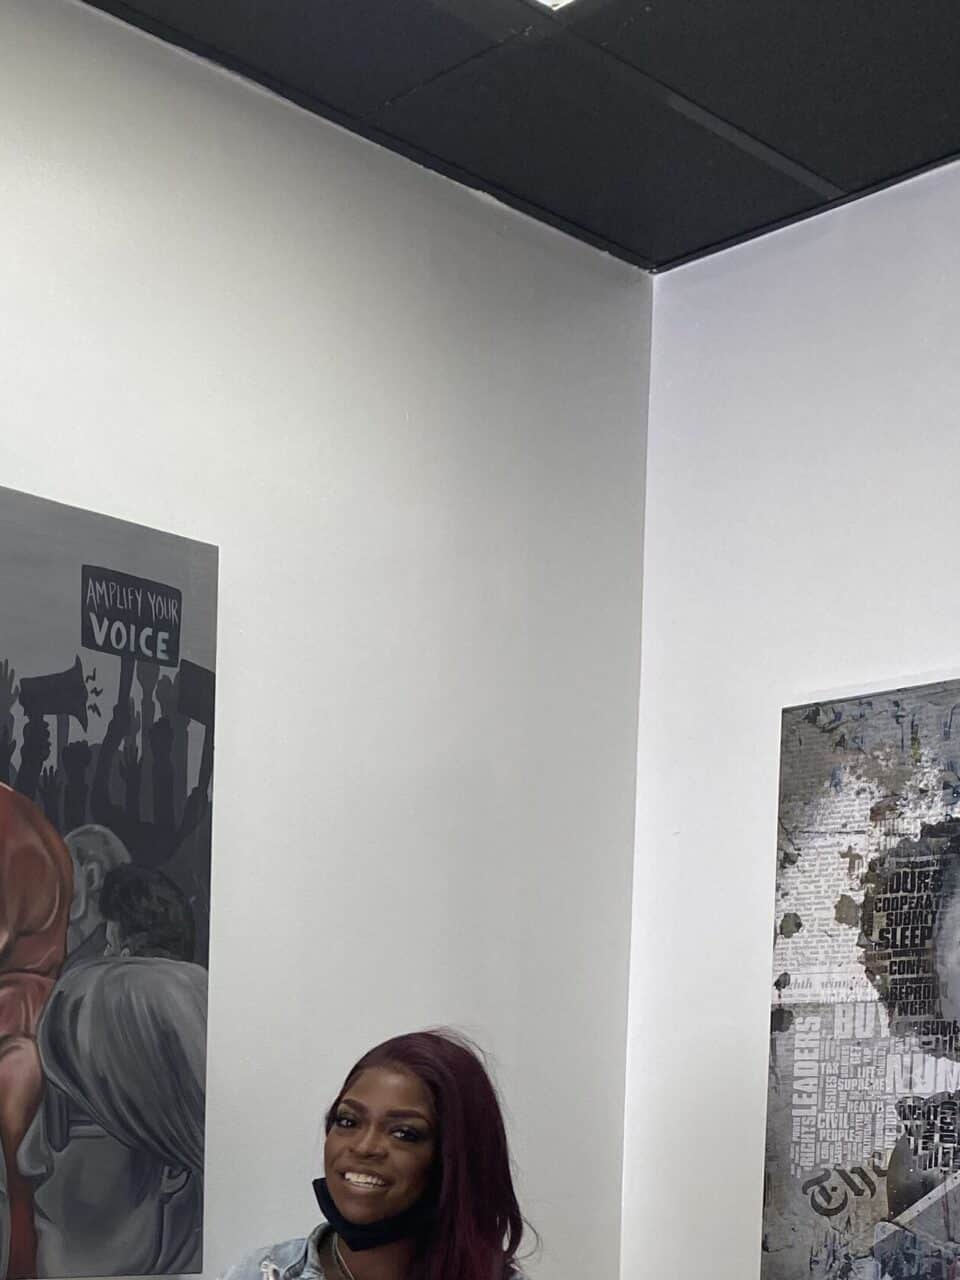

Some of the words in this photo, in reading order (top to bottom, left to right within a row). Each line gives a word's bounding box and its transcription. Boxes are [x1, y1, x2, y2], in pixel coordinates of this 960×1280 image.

[86, 577, 143, 617] AMPLIFY
[147, 591, 179, 626] YOUR
[89, 612, 170, 660] VOICE
[879, 926, 933, 950] SLEEP
[792, 1016, 821, 1117] LEADERS
[817, 1113, 849, 1128] CIVIL
